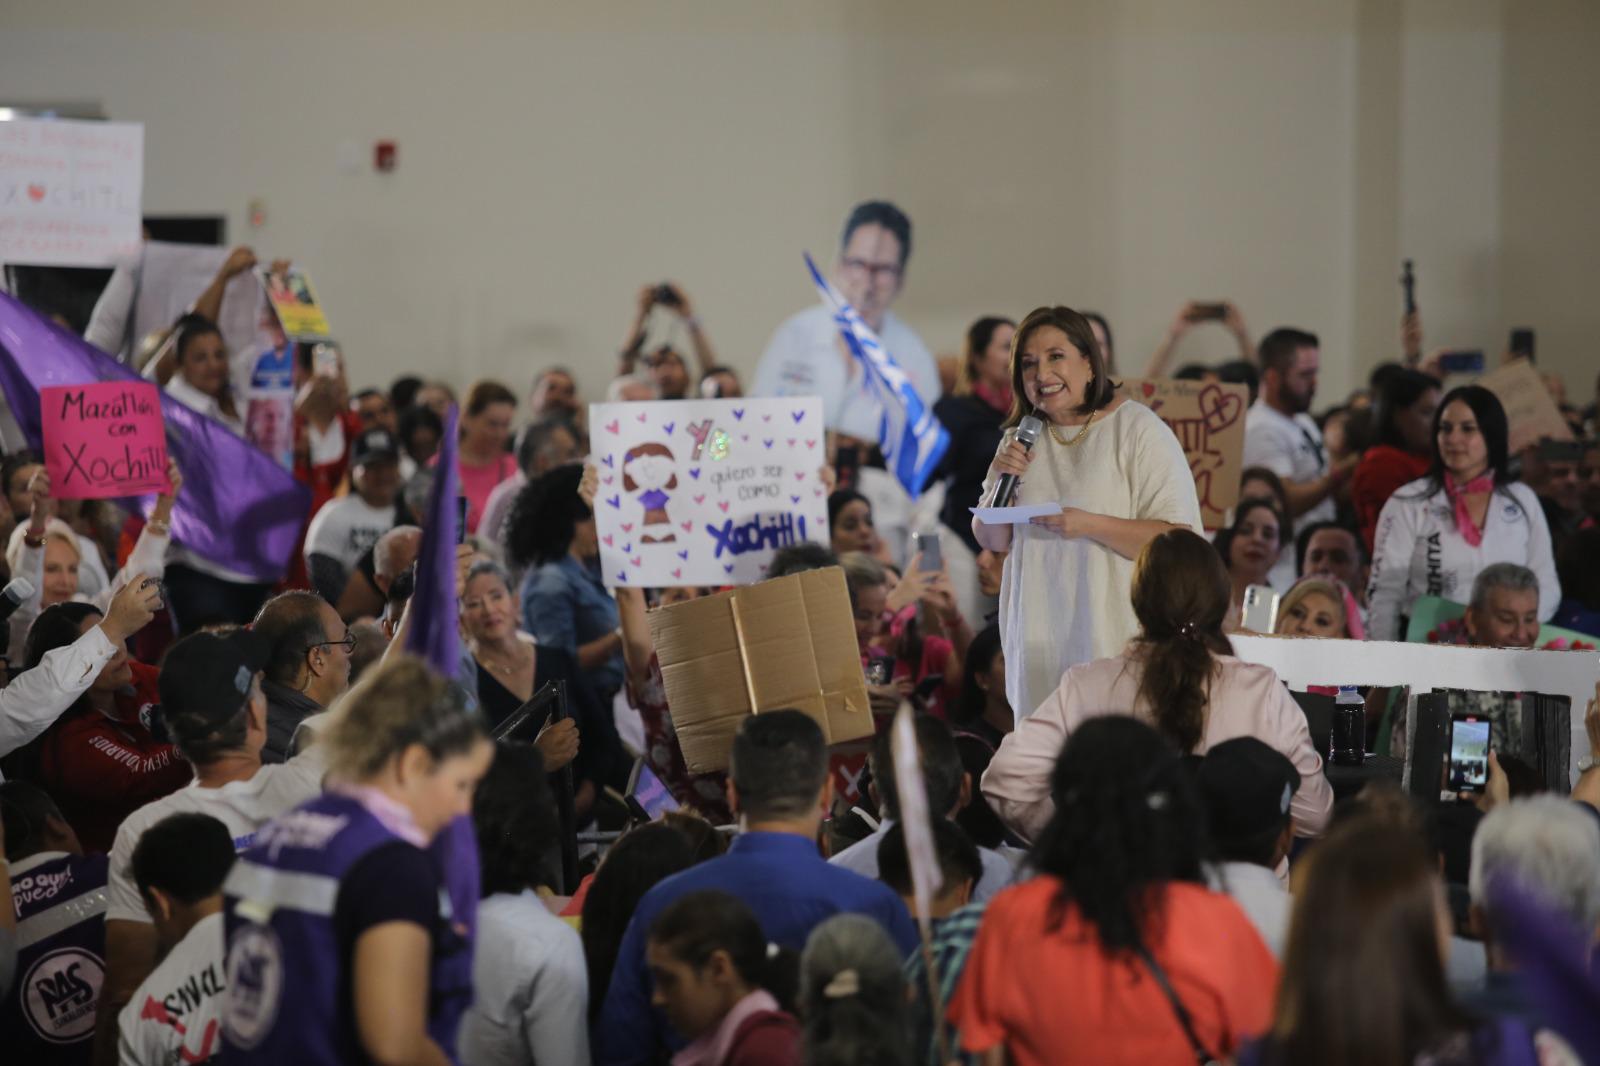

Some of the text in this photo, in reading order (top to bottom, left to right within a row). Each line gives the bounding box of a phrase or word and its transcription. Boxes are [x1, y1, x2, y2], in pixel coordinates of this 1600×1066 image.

[108, 424, 137, 437] con
[710, 465, 784, 494] quiero ser
